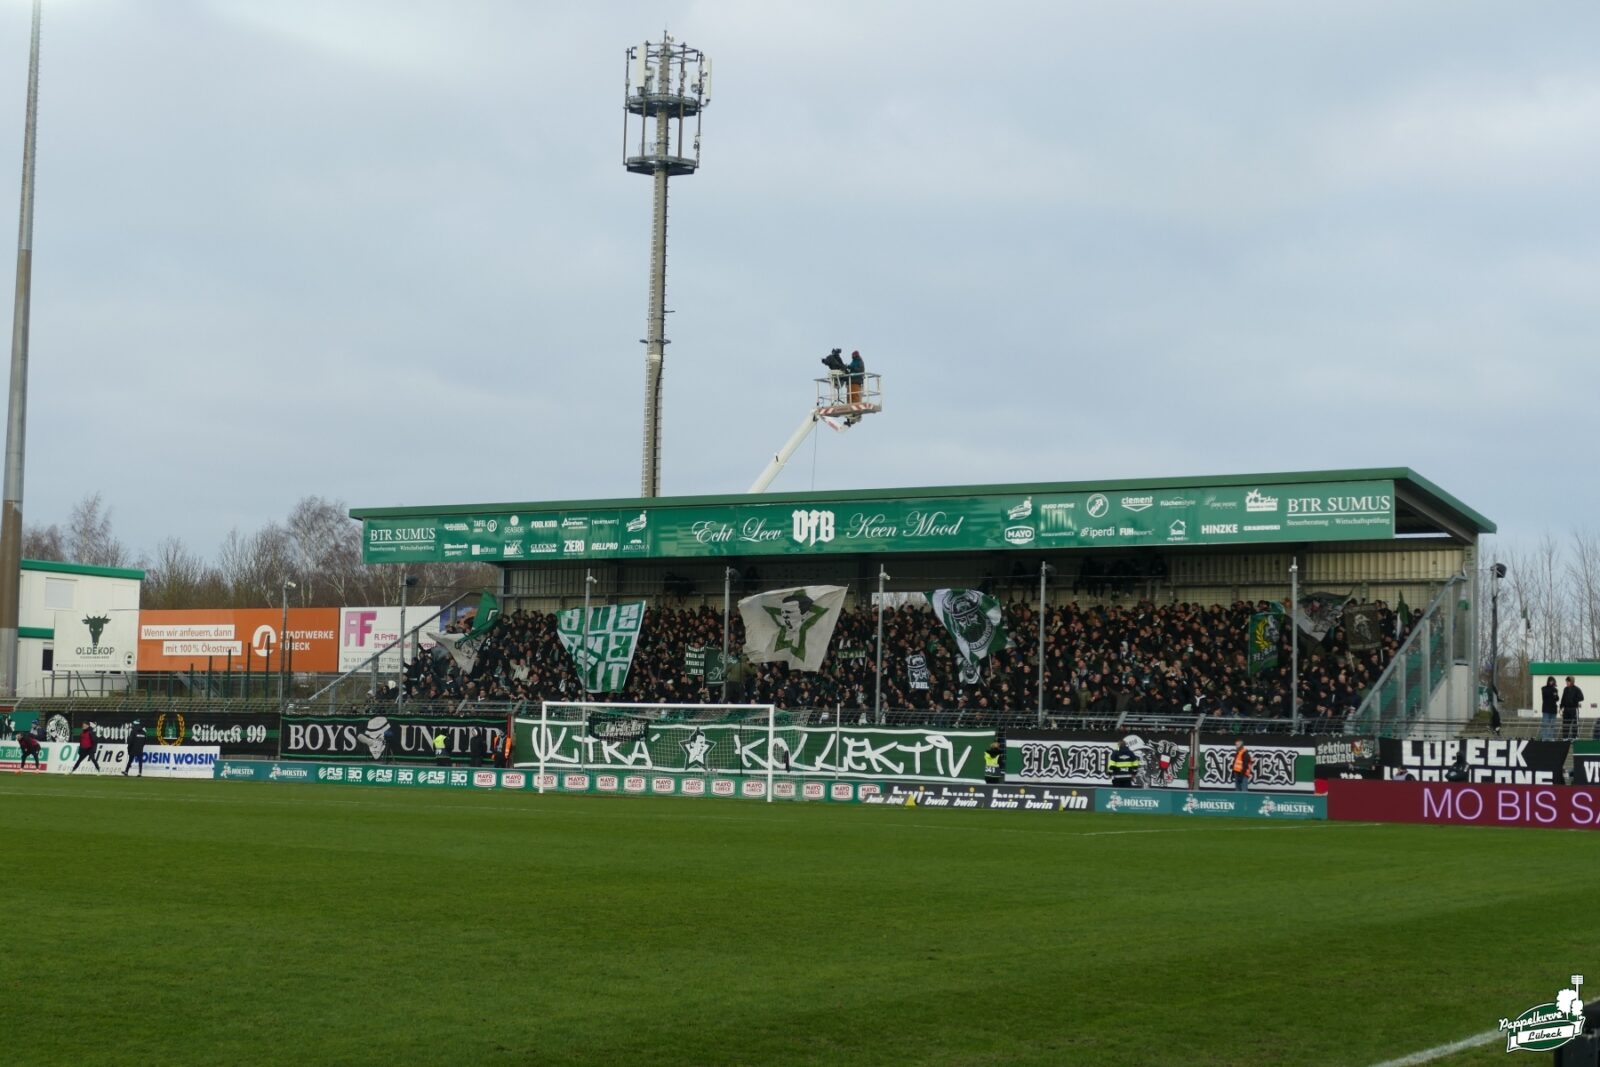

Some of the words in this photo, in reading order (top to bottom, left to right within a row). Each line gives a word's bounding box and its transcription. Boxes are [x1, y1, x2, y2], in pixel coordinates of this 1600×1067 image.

[1287, 498, 1322, 512] BTR
[1327, 496, 1391, 512] SUMUS
[691, 520, 732, 544] Echt
[792, 509, 835, 546] VfB
[846, 512, 898, 538] Keen
[902, 510, 964, 536] Mood
[1202, 524, 1238, 534] HINZKE
[370, 530, 392, 540] BTR
[396, 528, 436, 540] SUMUS
[144, 629, 164, 638] Wenn
[214, 628, 232, 636] dann
[280, 630, 334, 639] STADTWERKE
[76, 646, 115, 656] OLDEKOP
[166, 644, 178, 653] mit
[246, 725, 266, 742] 99
[288, 724, 356, 751] BOYS
[1318, 742, 1352, 754] sektion
[173, 753, 217, 764] WOISIN
[327, 768, 342, 776] FLS
[348, 770, 362, 779] 30
[376, 770, 392, 778] FLS
[398, 772, 413, 781] 30
[428, 771, 445, 780] FLS
[452, 773, 467, 782] 30
[925, 797, 950, 806] bwin
[954, 798, 978, 807] bwin
[990, 799, 1018, 808] bwin
[1026, 800, 1053, 810] bwin
[1424, 788, 1483, 820] MO
[1498, 790, 1558, 822] BIS
[1277, 804, 1314, 812] HOLSTEN
